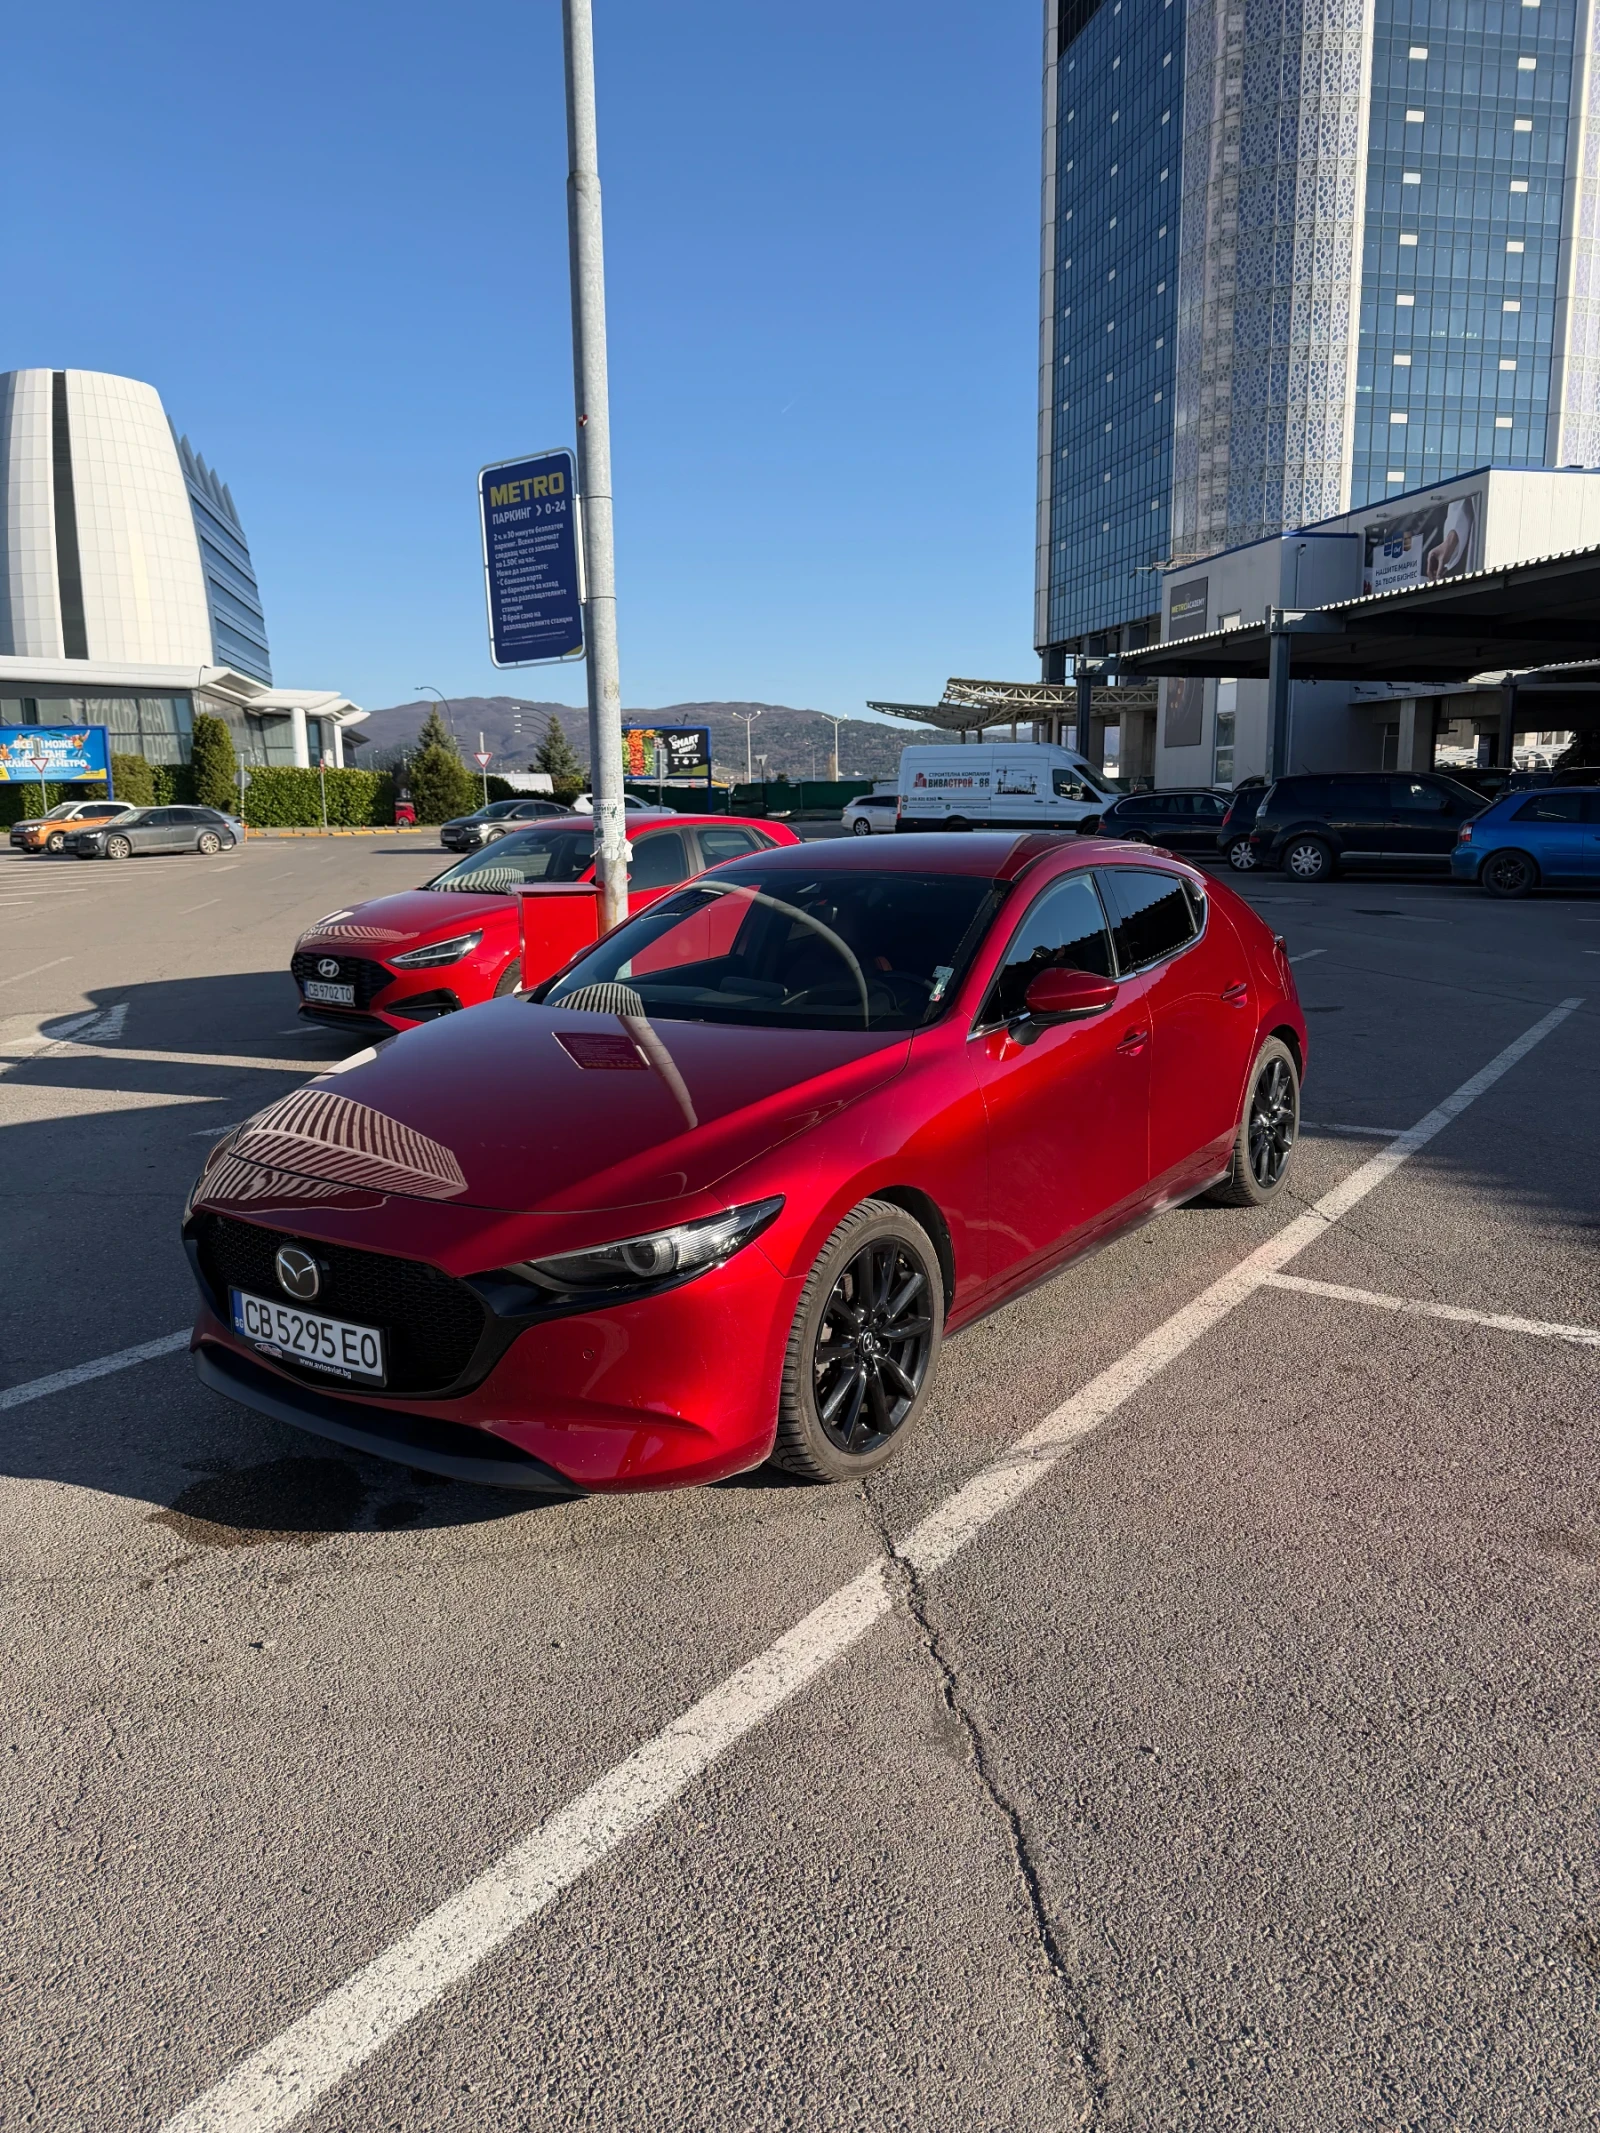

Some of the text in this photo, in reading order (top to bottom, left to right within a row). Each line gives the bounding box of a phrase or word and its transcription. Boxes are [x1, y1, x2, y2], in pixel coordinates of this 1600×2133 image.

[490, 472, 564, 507] METRO
[492, 507, 532, 525] ПАРКИНГ
[494, 533, 498, 541] 2
[507, 530, 514, 539] 30
[515, 528, 534, 538] минути
[535, 523, 564, 534] безплатен
[494, 533, 560, 551] паркинг. Всеки започнат
[495, 550, 518, 560] следващ
[535, 542, 559, 552] заплаща
[520, 564, 549, 574] заплатите:
[1376, 560, 1418, 576] НАШИТЕ МАРКИ
[504, 576, 526, 585] банкова
[526, 574, 542, 582] карта
[1375, 571, 1418, 587] ЗА ТВОЯ БИЗНЕС
[508, 584, 535, 595] бариерите
[519, 589, 567, 603] разплащателните
[503, 616, 573, 633] разплащателните станции
[508, 612, 520, 622] брой
[44, 740, 74, 748] МОЖЕ
[672, 734, 699, 749] SMART
[56, 760, 87, 768] МЕТРО
[928, 776, 973, 788] ВИВАСТРОЙ
[979, 778, 990, 788] 88
[309, 983, 352, 1001] CB 9702 TO
[235, 1316, 244, 1328] BG
[246, 1300, 273, 1340] CB
[277, 1310, 336, 1358] 5295
